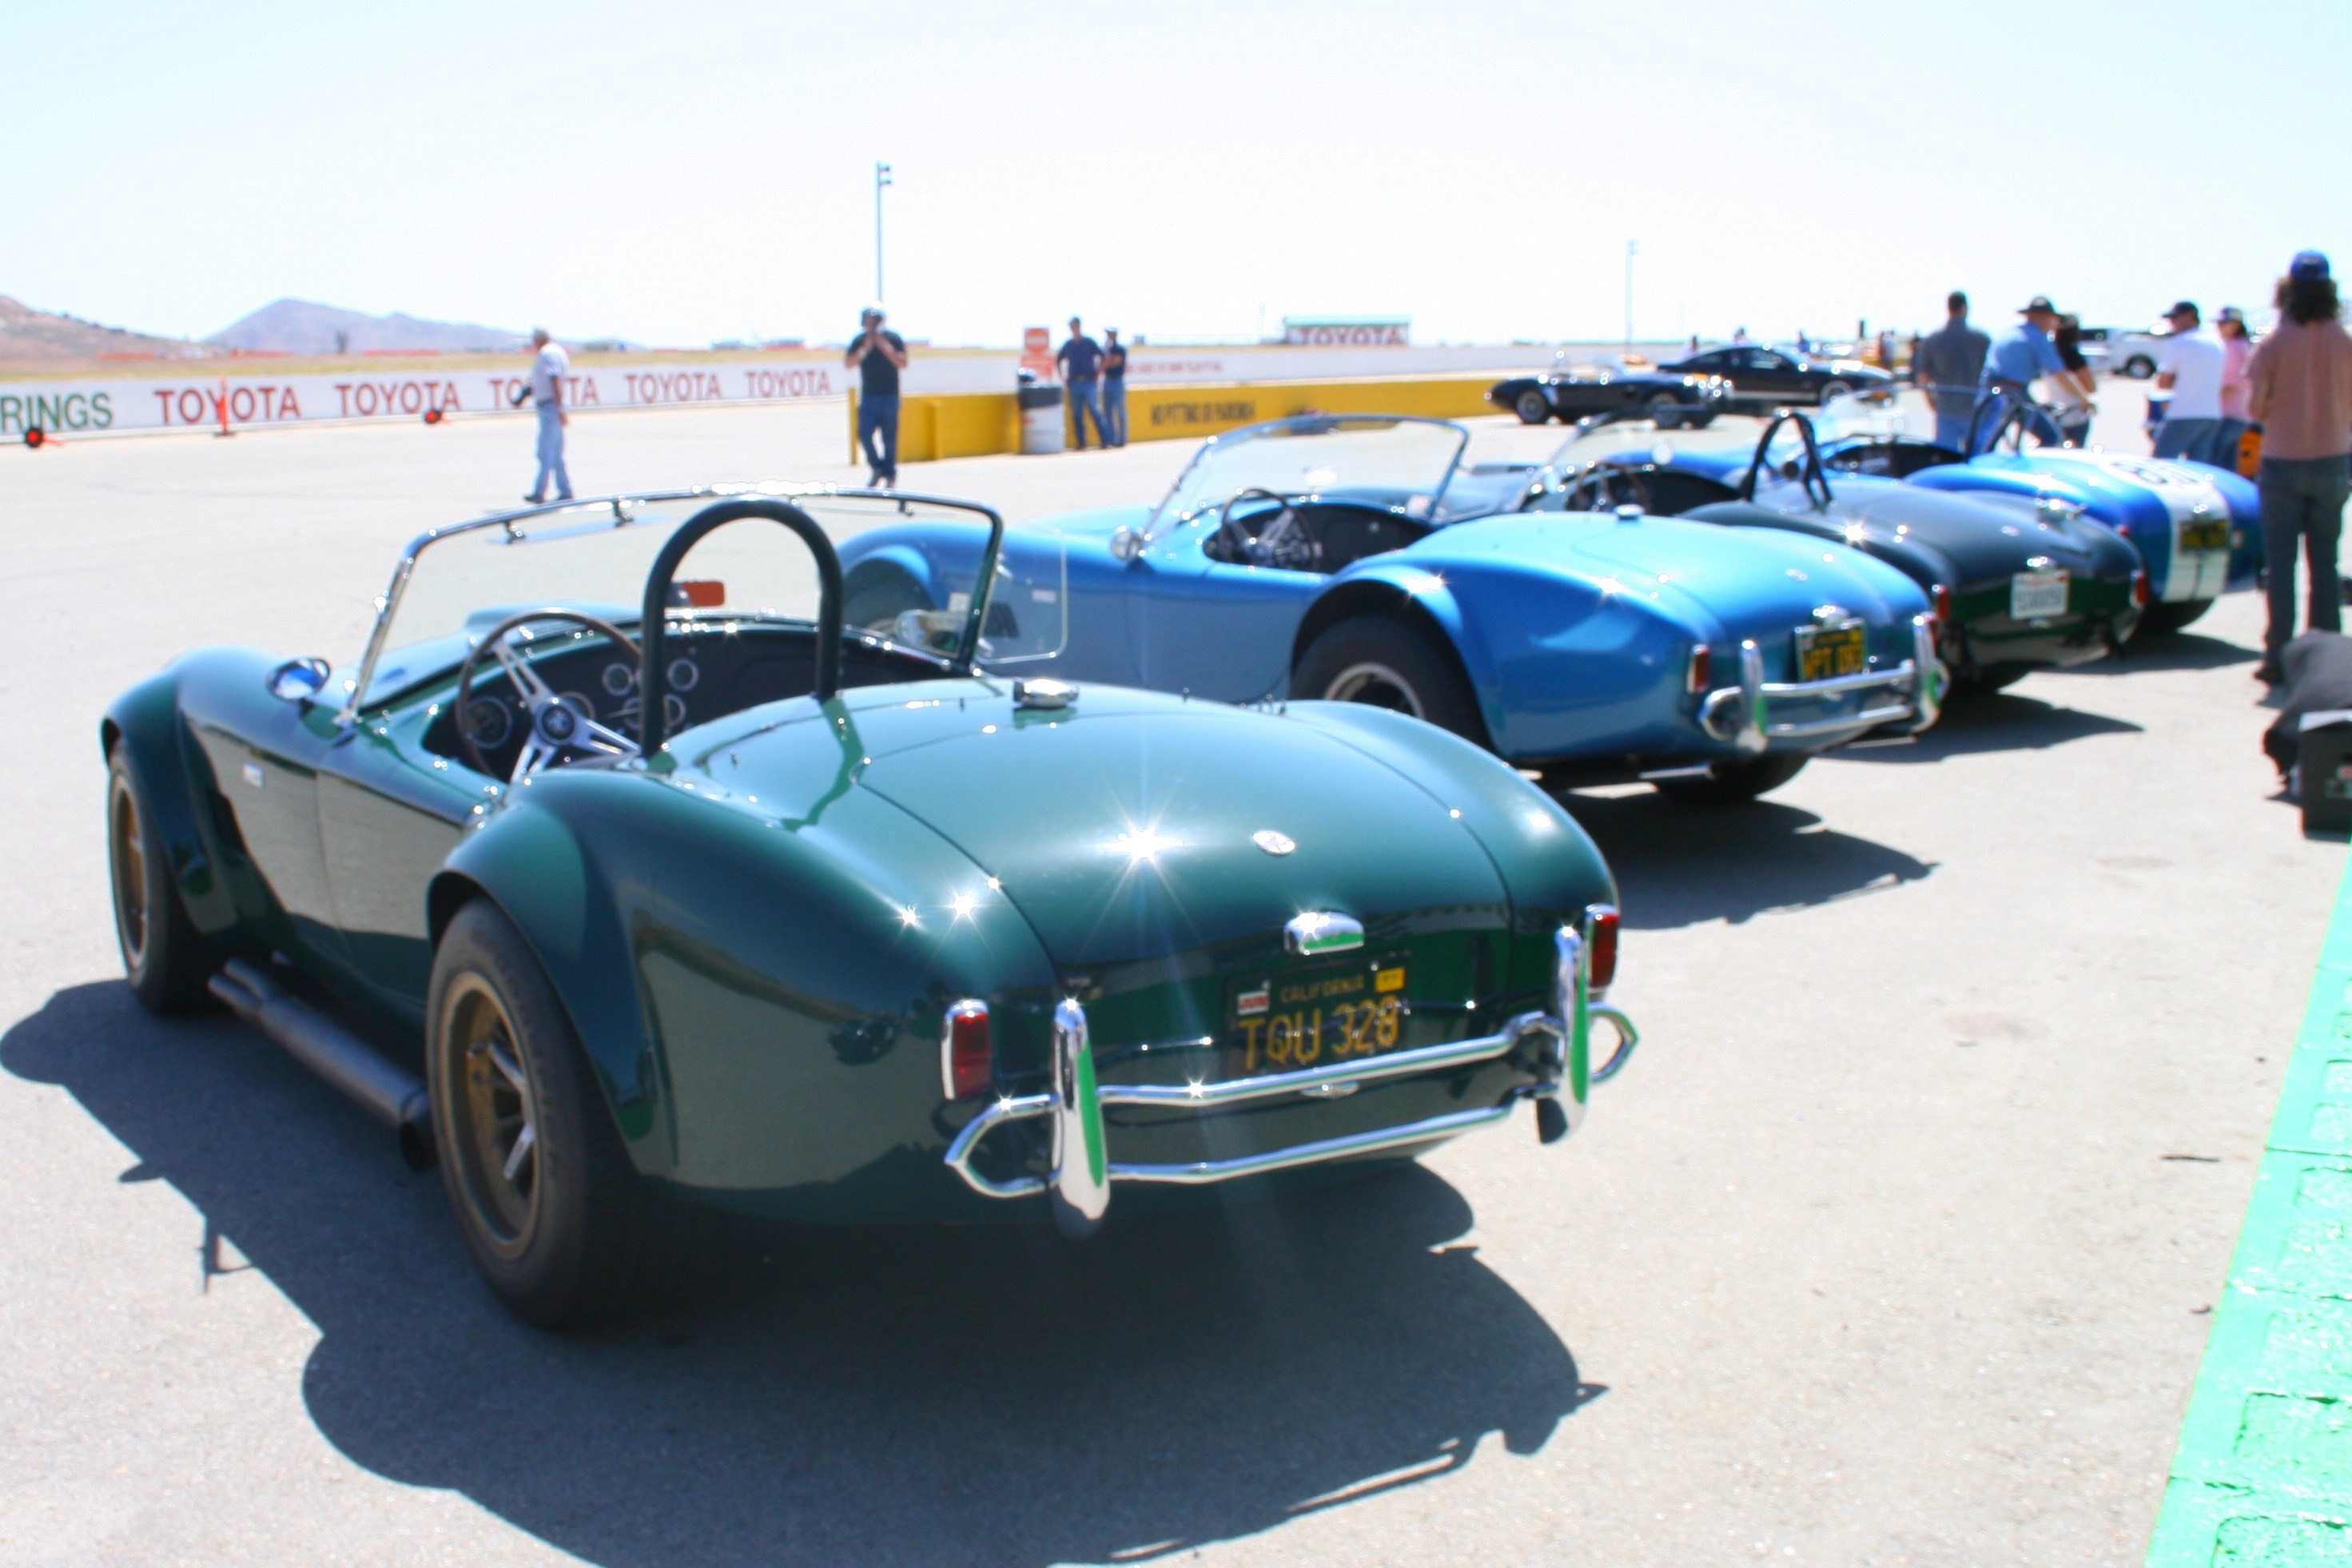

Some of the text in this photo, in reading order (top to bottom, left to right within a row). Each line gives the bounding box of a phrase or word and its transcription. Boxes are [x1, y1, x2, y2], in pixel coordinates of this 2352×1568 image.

[1297, 326, 1404, 346] TOYOTA
[334, 380, 462, 417] TOYOTA
[489, 377, 598, 409] TOTA
[625, 372, 722, 403] TOYOTA
[745, 369, 832, 398] TOYOTA
[0, 392, 113, 432] RINGS
[1331, 994, 1399, 1055] 328
